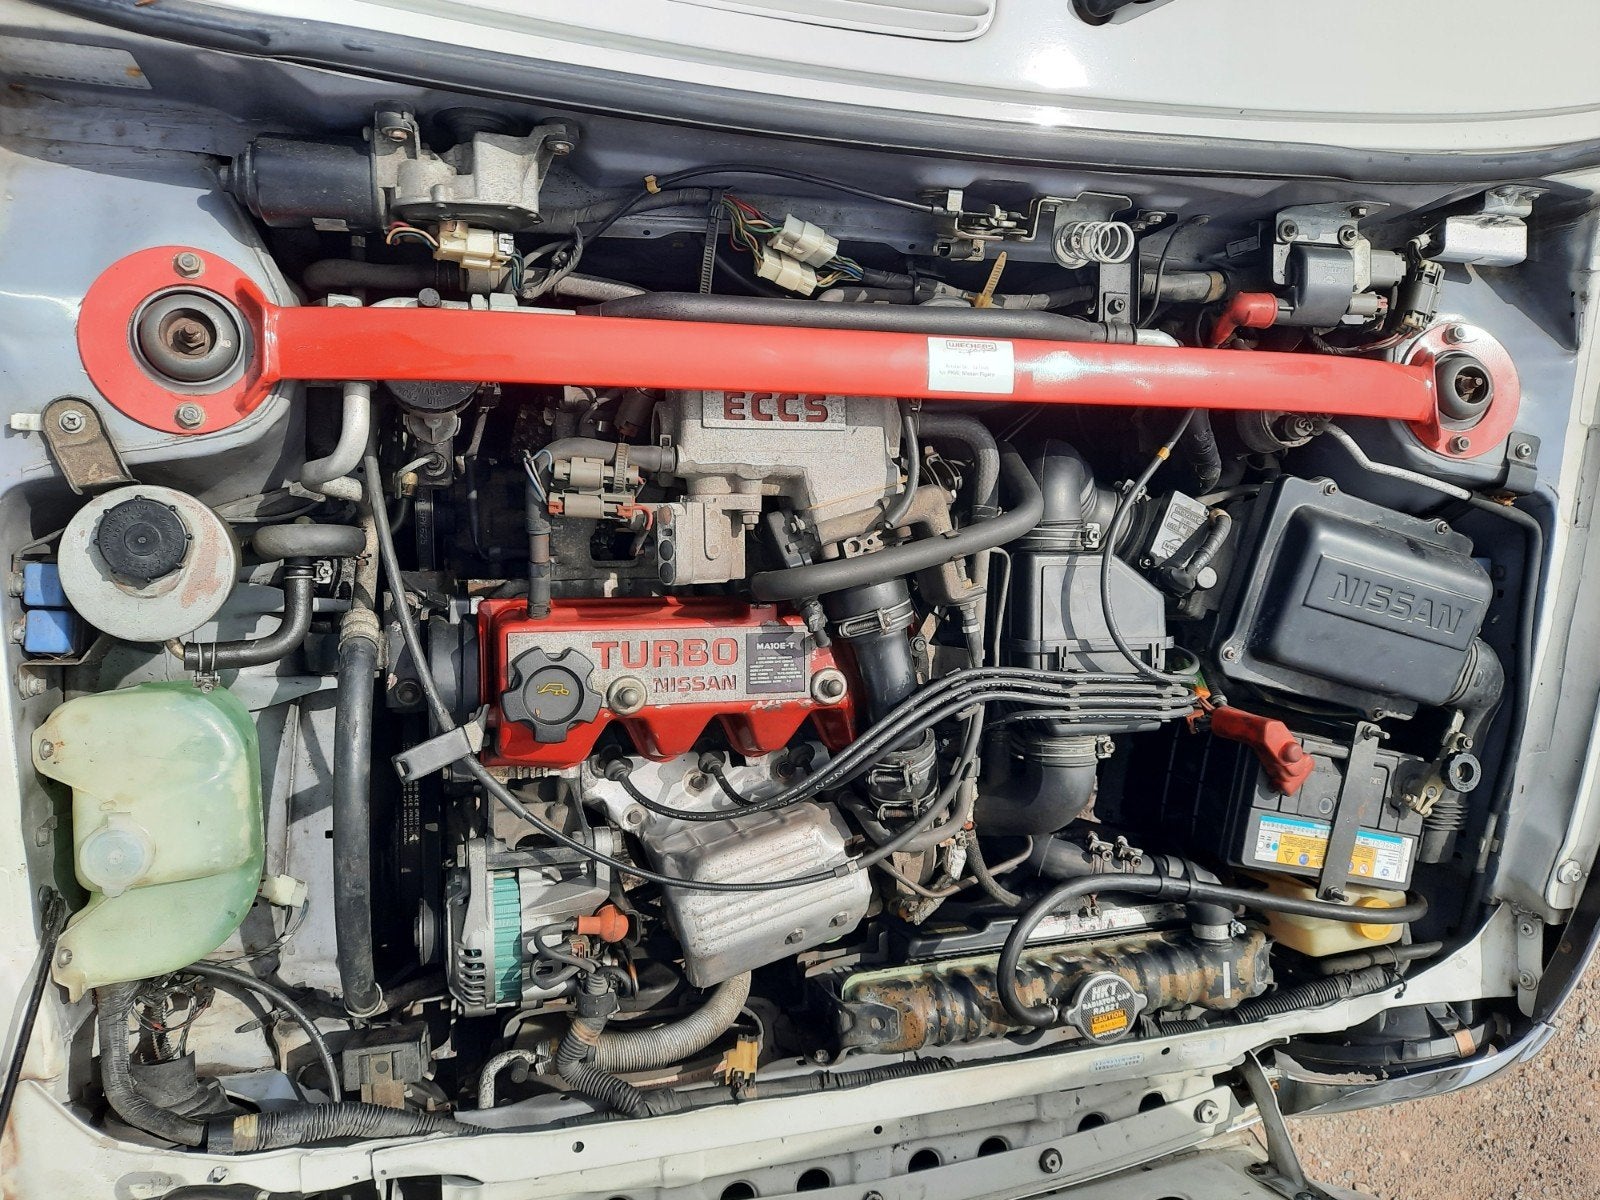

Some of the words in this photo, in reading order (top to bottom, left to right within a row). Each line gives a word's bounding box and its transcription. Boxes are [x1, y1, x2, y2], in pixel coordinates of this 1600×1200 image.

[723, 391, 829, 423] ECCS
[1328, 572, 1464, 635] NISSAN
[592, 637, 739, 670] TURBO
[756, 642, 795, 650] MA10E-T
[652, 674, 737, 693] NISSAN
[1092, 981, 1119, 1000] HKT
[1082, 996, 1116, 1010] RADIATOR
[1117, 992, 1131, 1001] CAP
[1094, 1010, 1124, 1023] CAUTION
